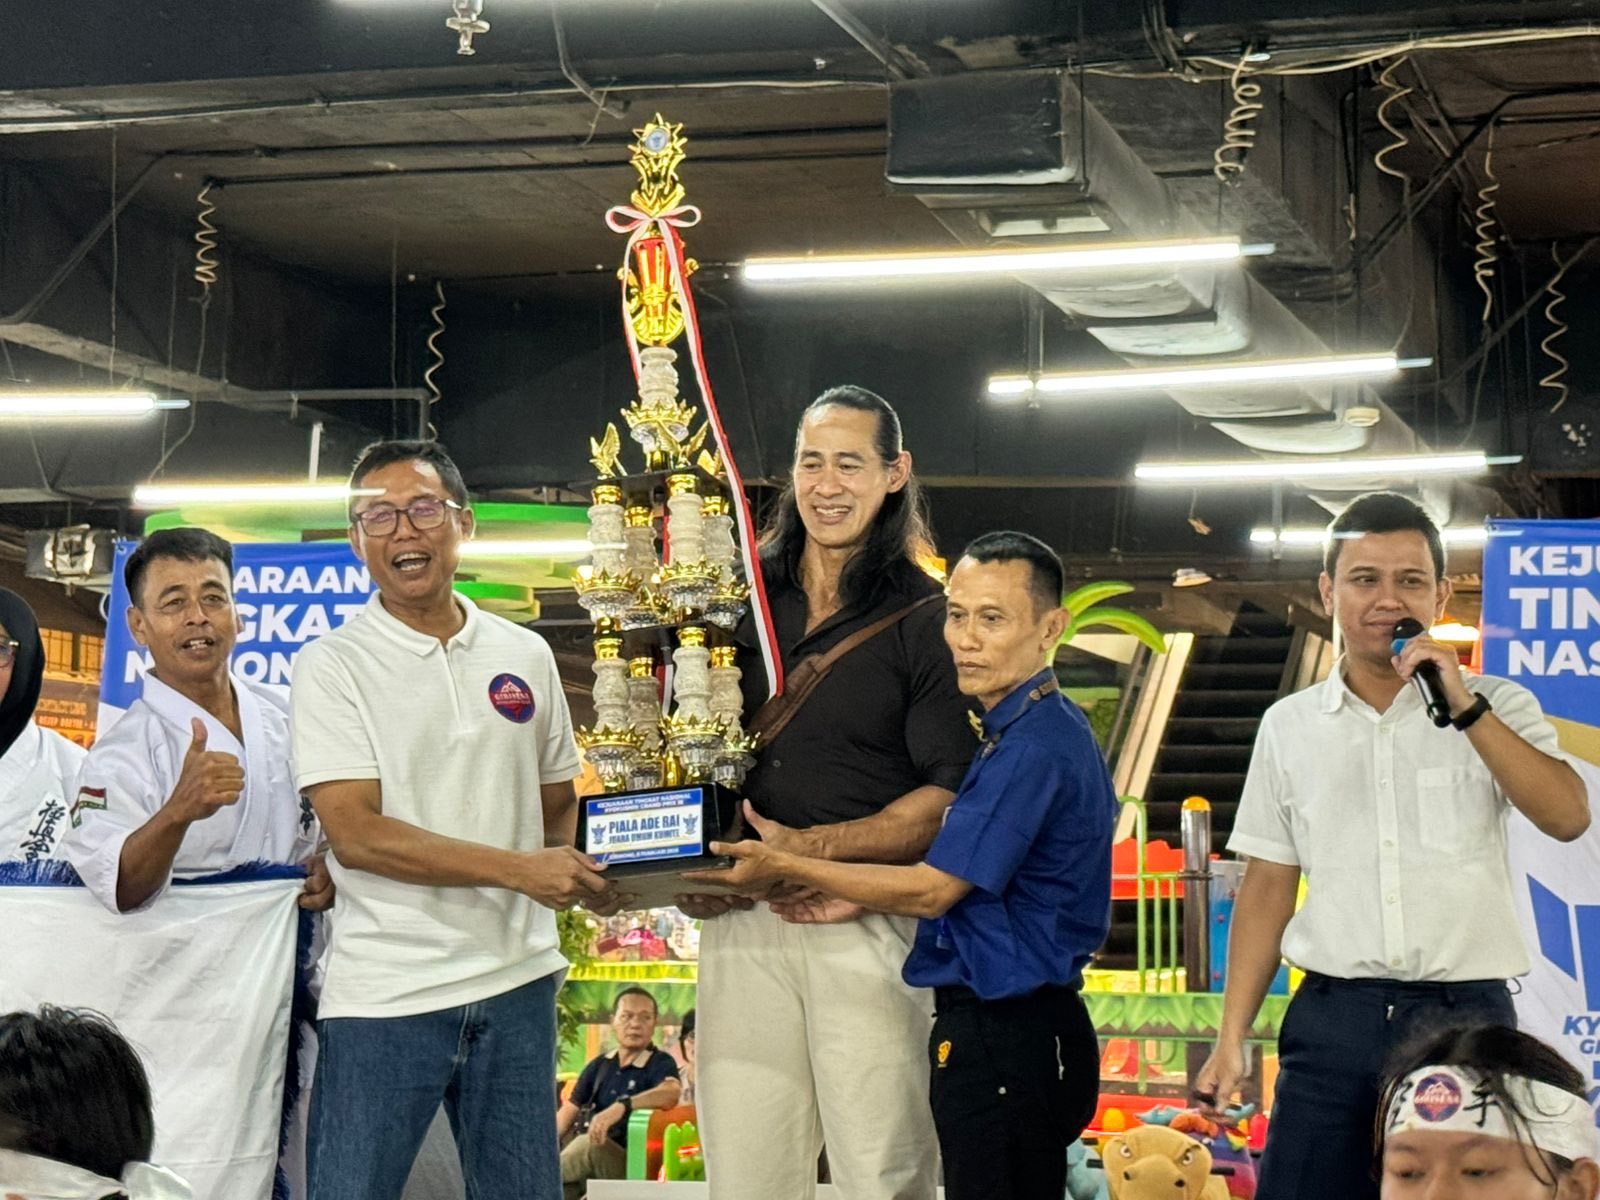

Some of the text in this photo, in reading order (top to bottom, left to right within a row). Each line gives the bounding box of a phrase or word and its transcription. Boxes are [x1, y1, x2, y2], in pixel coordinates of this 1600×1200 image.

[1510, 546, 1600, 576] KEJ
[233, 566, 371, 594] ARAAN
[235, 603, 367, 643] GKAT
[609, 814, 680, 834] PIALA ADE RAI
